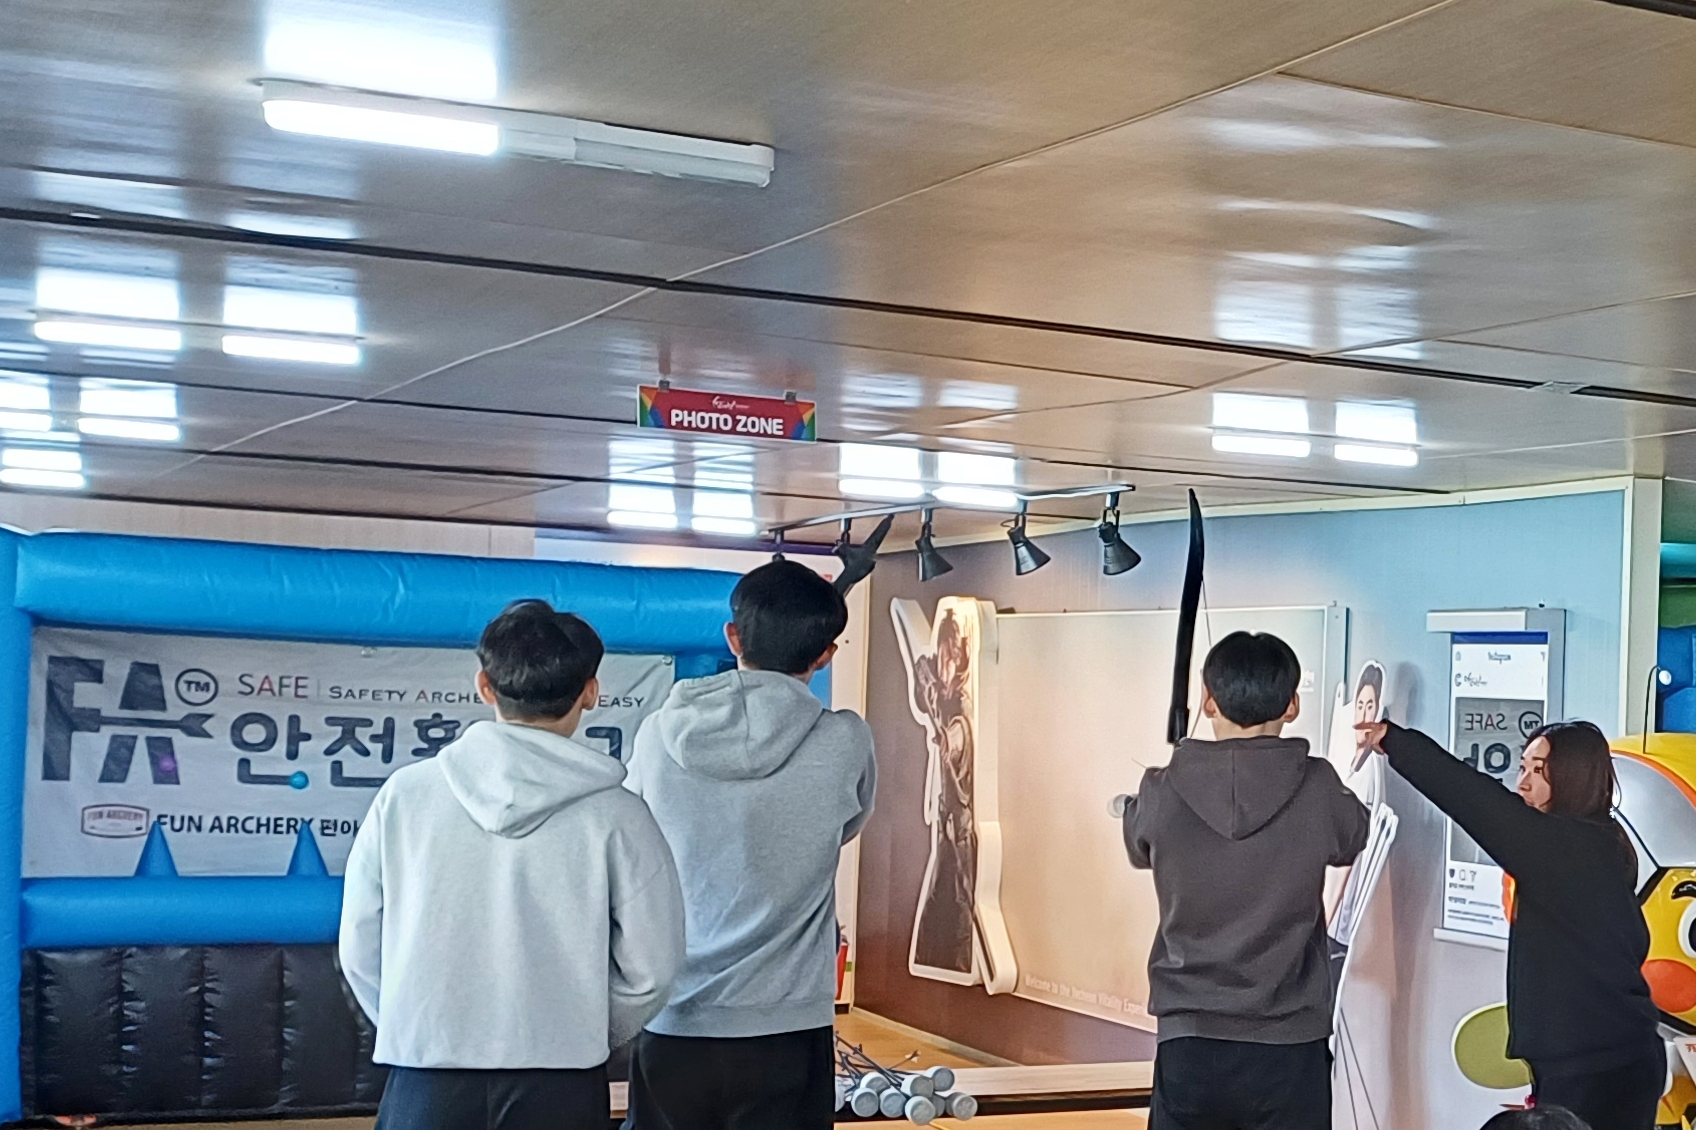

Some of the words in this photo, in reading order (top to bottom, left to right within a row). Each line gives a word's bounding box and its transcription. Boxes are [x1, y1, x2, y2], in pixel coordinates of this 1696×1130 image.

[670, 408, 733, 431] PHOTO
[735, 415, 784, 435] ZONE
[237, 673, 310, 699] SAFE
[328, 685, 407, 701] SAFETY
[597, 695, 645, 708] EASY
[156, 813, 204, 834] FUN
